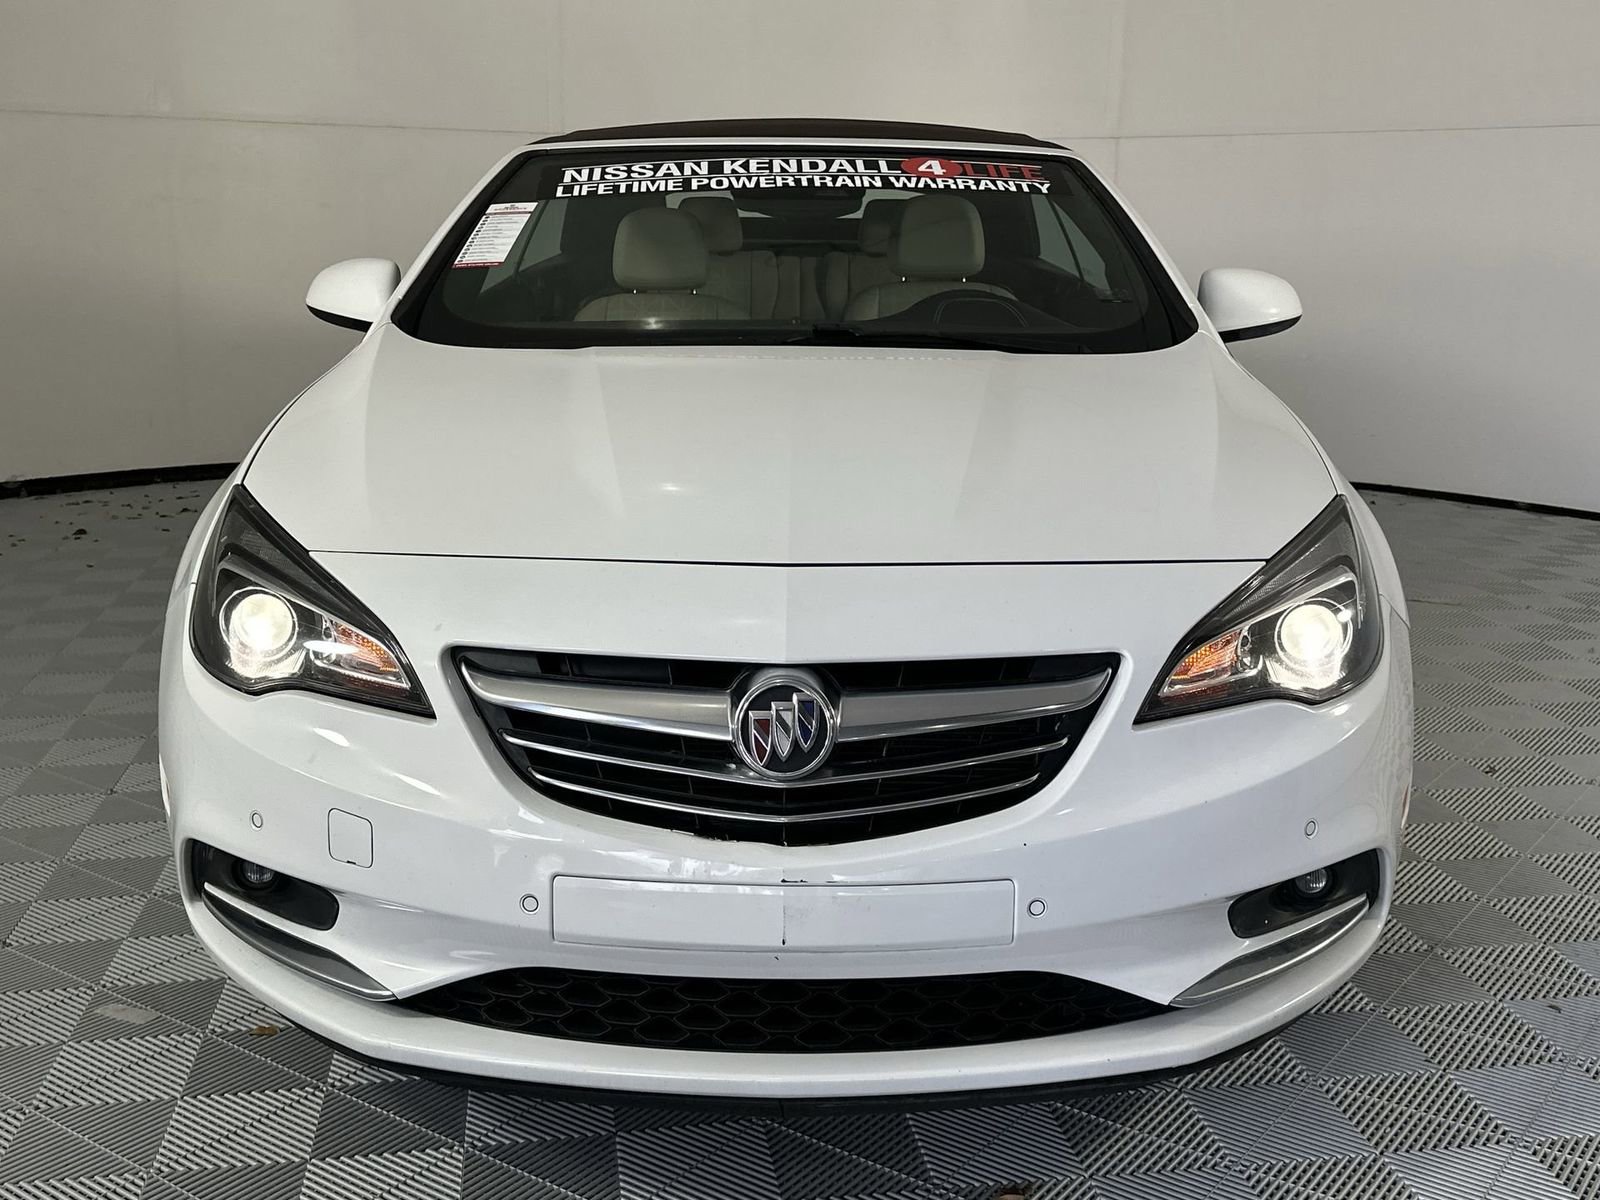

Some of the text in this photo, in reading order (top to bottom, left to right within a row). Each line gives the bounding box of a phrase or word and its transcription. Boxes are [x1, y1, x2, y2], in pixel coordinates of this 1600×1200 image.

[563, 159, 1045, 182] NISSAN KENDALL 4 LIFE
[556, 175, 1051, 197] LIFETIME POWERTRAIN WARRANTY
